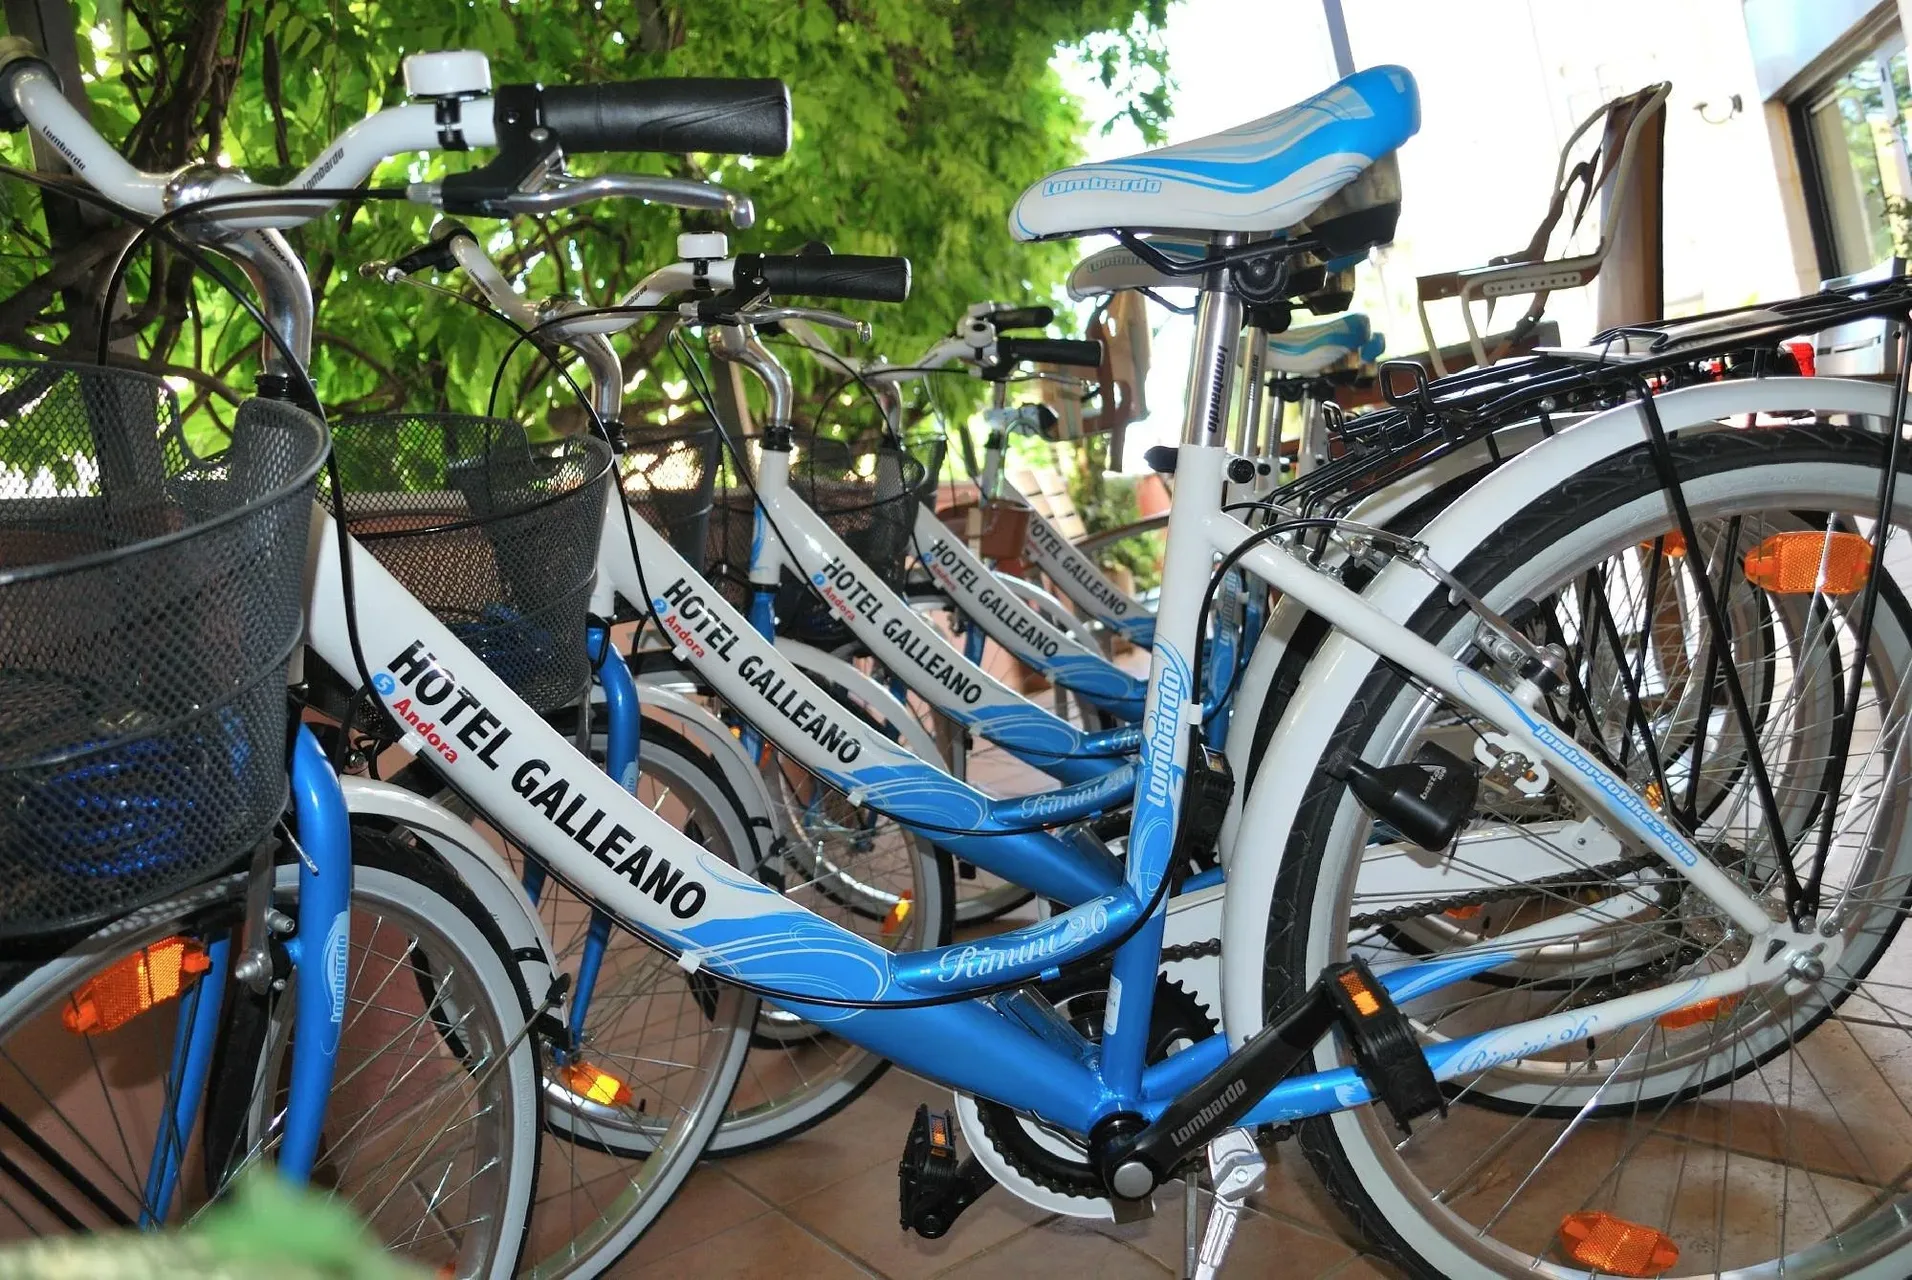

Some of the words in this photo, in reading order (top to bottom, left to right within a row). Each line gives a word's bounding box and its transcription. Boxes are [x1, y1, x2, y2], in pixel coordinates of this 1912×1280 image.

[823, 586, 856, 621] Andora
[930, 540, 979, 593] HOTEL
[978, 589, 1059, 657] GALLEANO
[1062, 557, 1128, 616] GALLEANO
[665, 615, 705, 658] Andora
[823, 556, 883, 624] HOTEL
[883, 618, 982, 704] GALLEANO
[663, 578, 740, 663] HOTEL
[738, 655, 862, 764] GALLEANO
[392, 698, 459, 764] Andora
[387, 639, 513, 771] HOTEL
[511, 758, 707, 919] GALLEANO
[938, 924, 1058, 982] Rimini
